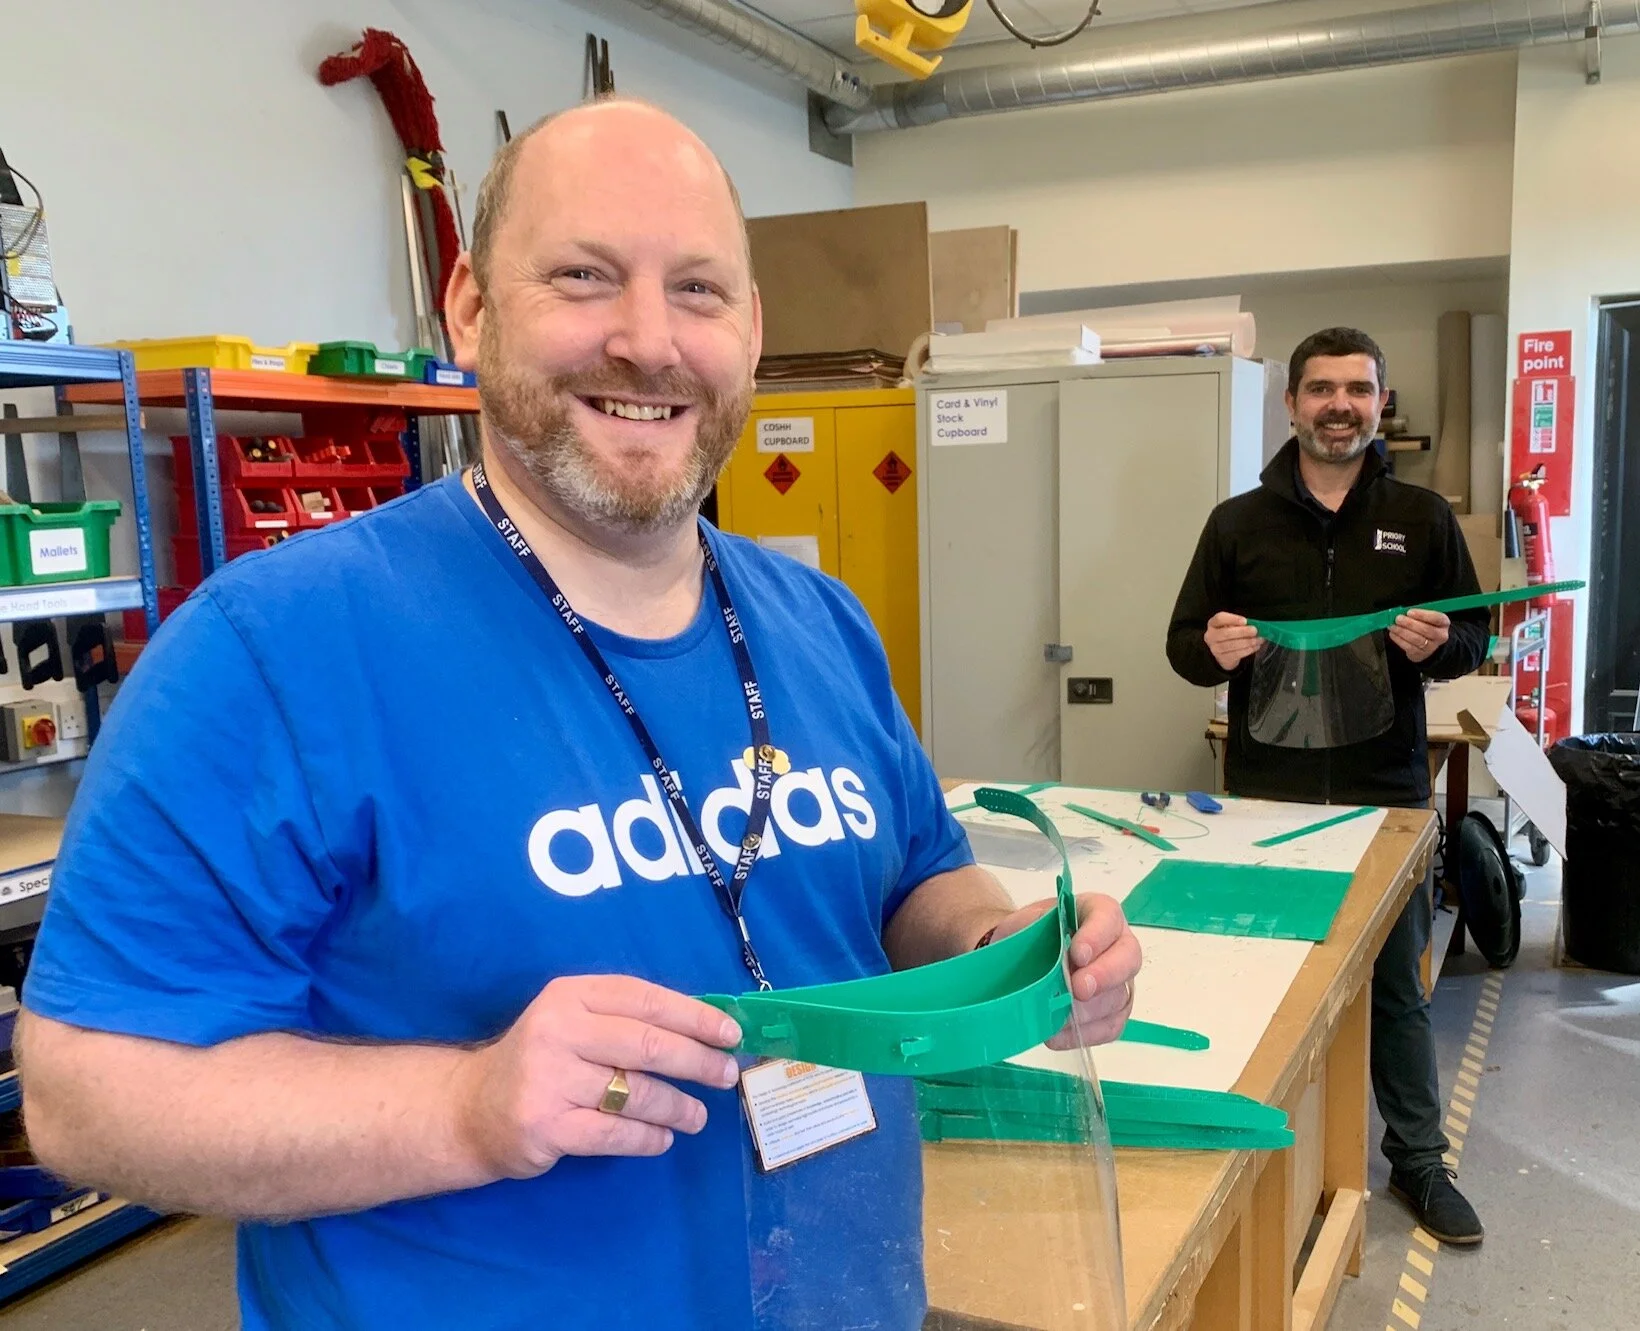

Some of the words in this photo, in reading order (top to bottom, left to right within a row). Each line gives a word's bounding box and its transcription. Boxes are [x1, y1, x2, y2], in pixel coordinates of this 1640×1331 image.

[1523, 338, 1554, 353] Fire
[1523, 355, 1564, 374] point
[936, 399, 960, 409] Card
[963, 399, 970, 408] &
[973, 396, 998, 408] Vinyl
[763, 423, 792, 432] COSHH
[937, 413, 964, 423] Stock
[764, 436, 810, 446] CUPBOARD
[937, 426, 987, 439] Cupboard
[497, 517, 531, 557] STAFF
[1382, 542, 1407, 553] SCHOOL
[40, 545, 78, 558] Mallets
[552, 593, 584, 634] STAFF
[723, 606, 744, 644] STAFF
[605, 673, 635, 716] STAFF
[744, 680, 765, 719] STAFF
[653, 757, 680, 801] STAFF
[756, 758, 772, 800] STAFF
[528, 758, 877, 897] adidas
[696, 844, 724, 887] STAFF
[734, 849, 756, 880] STAF
[19, 874, 50, 893] Spec
